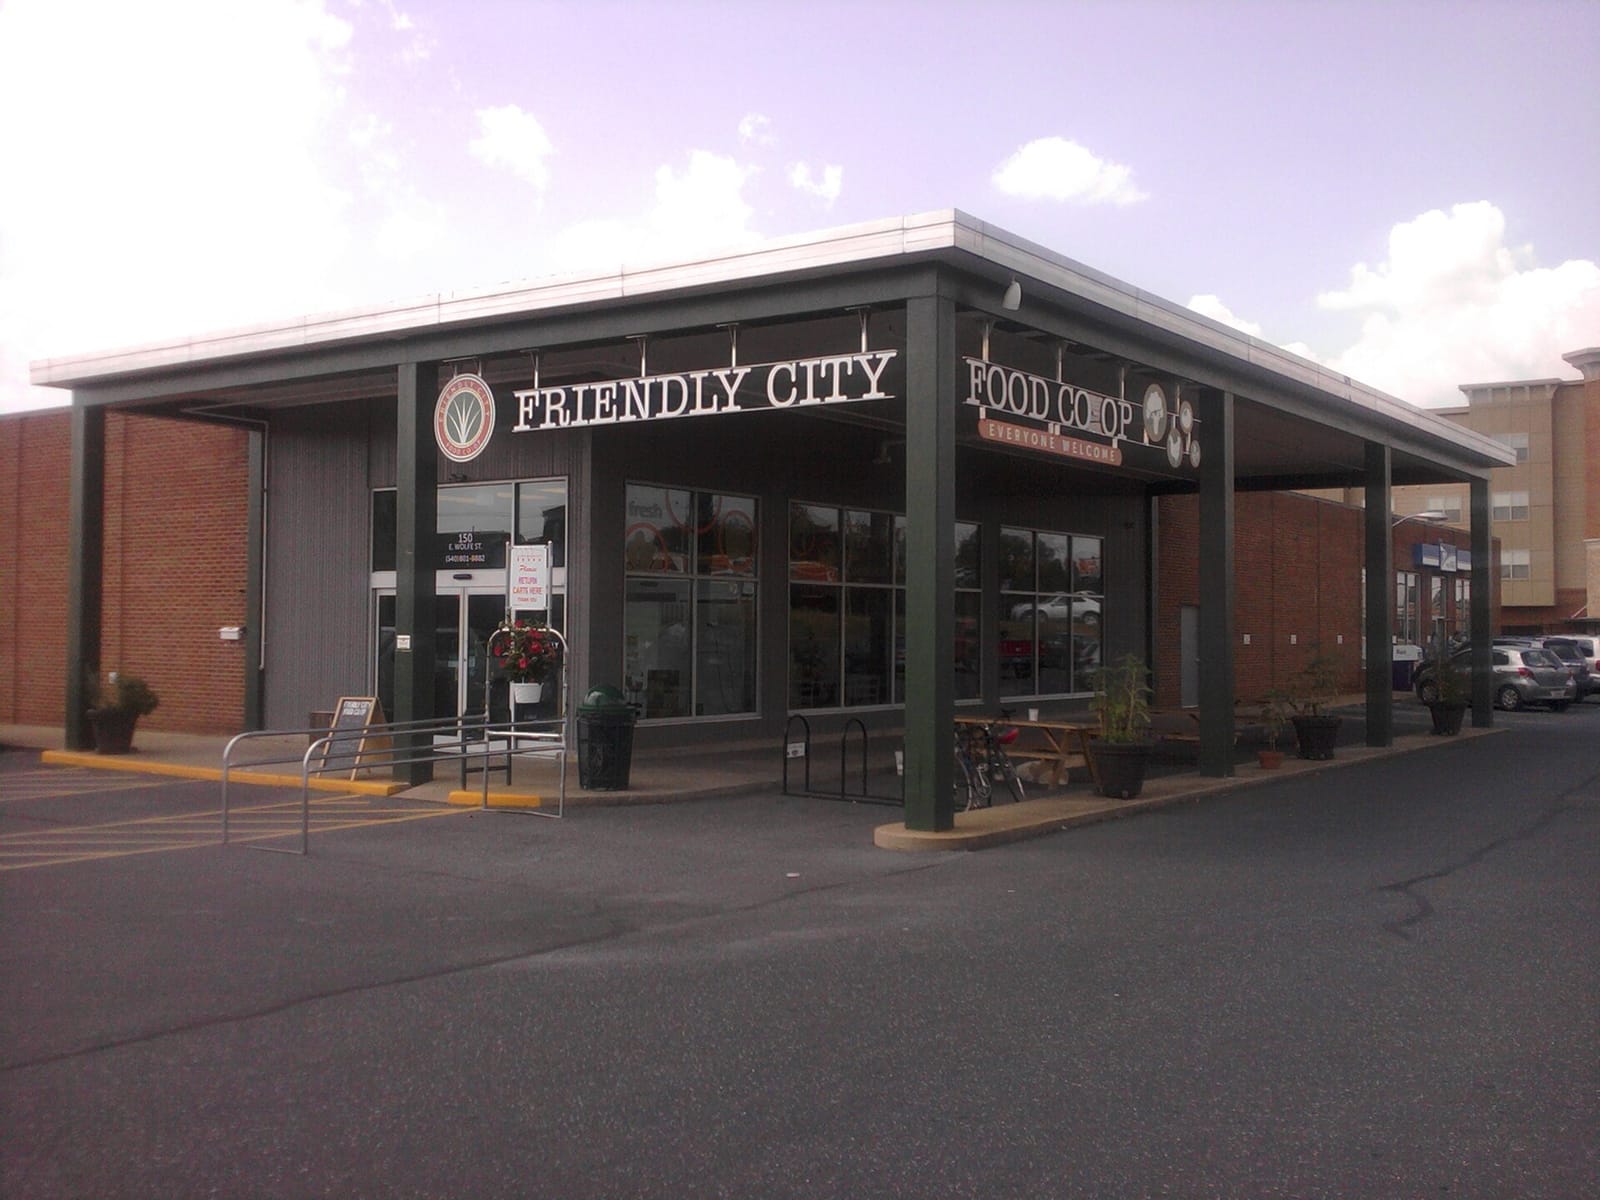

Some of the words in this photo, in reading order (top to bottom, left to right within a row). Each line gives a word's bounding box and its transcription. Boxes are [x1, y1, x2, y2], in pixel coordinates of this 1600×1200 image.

[511, 367, 751, 432] FRIENDLY
[766, 350, 898, 409] CITY
[965, 357, 1051, 421] FOOD
[988, 423, 1056, 449] EVERYONE
[1061, 439, 1117, 463] WELCOME
[628, 500, 663, 520] fresh
[458, 532, 473, 544] 150
[518, 576, 538, 585] RETURN
[529, 587, 543, 595] HERE
